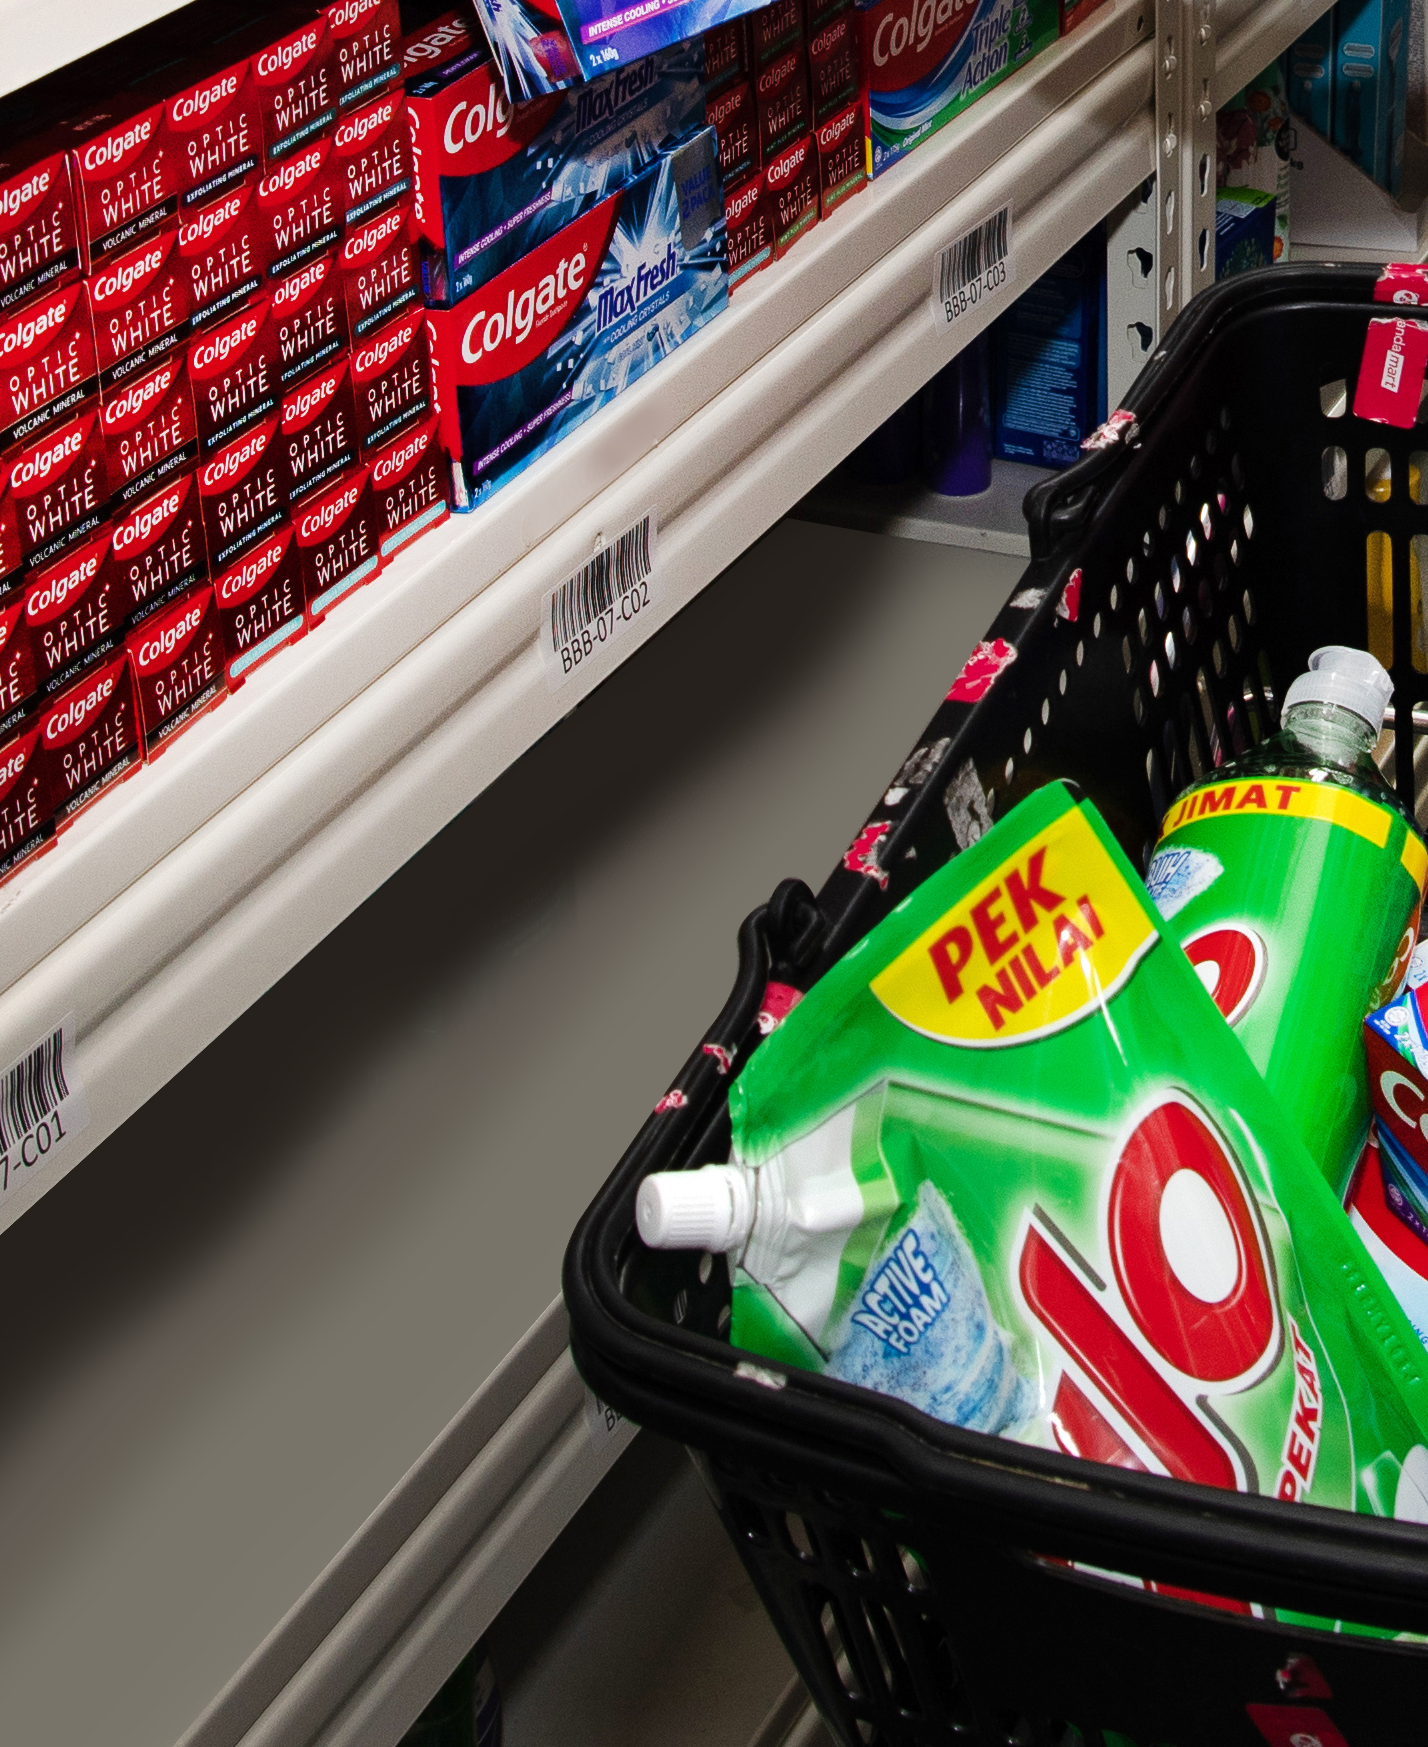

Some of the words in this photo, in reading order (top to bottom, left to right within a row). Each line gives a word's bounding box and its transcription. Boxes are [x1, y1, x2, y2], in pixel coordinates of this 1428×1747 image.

[589, 15, 624, 38] INTENSE
[624, 0, 661, 22] COOLING
[972, 8, 1011, 54] Triple
[961, 41, 1008, 101] Action
[461, 243, 588, 364] Colgate
[639, 291, 670, 322] CRYSTALS
[945, 262, 1007, 323] BBB-07-C03
[561, 581, 650, 674] BBB-07-C02
[1173, 784, 1301, 827] JIMAT
[927, 845, 1069, 1005] PEK
[975, 893, 1106, 1034] NILAI
[850, 1227, 937, 1341] ACTIVE
[887, 1277, 952, 1358] FOAM
